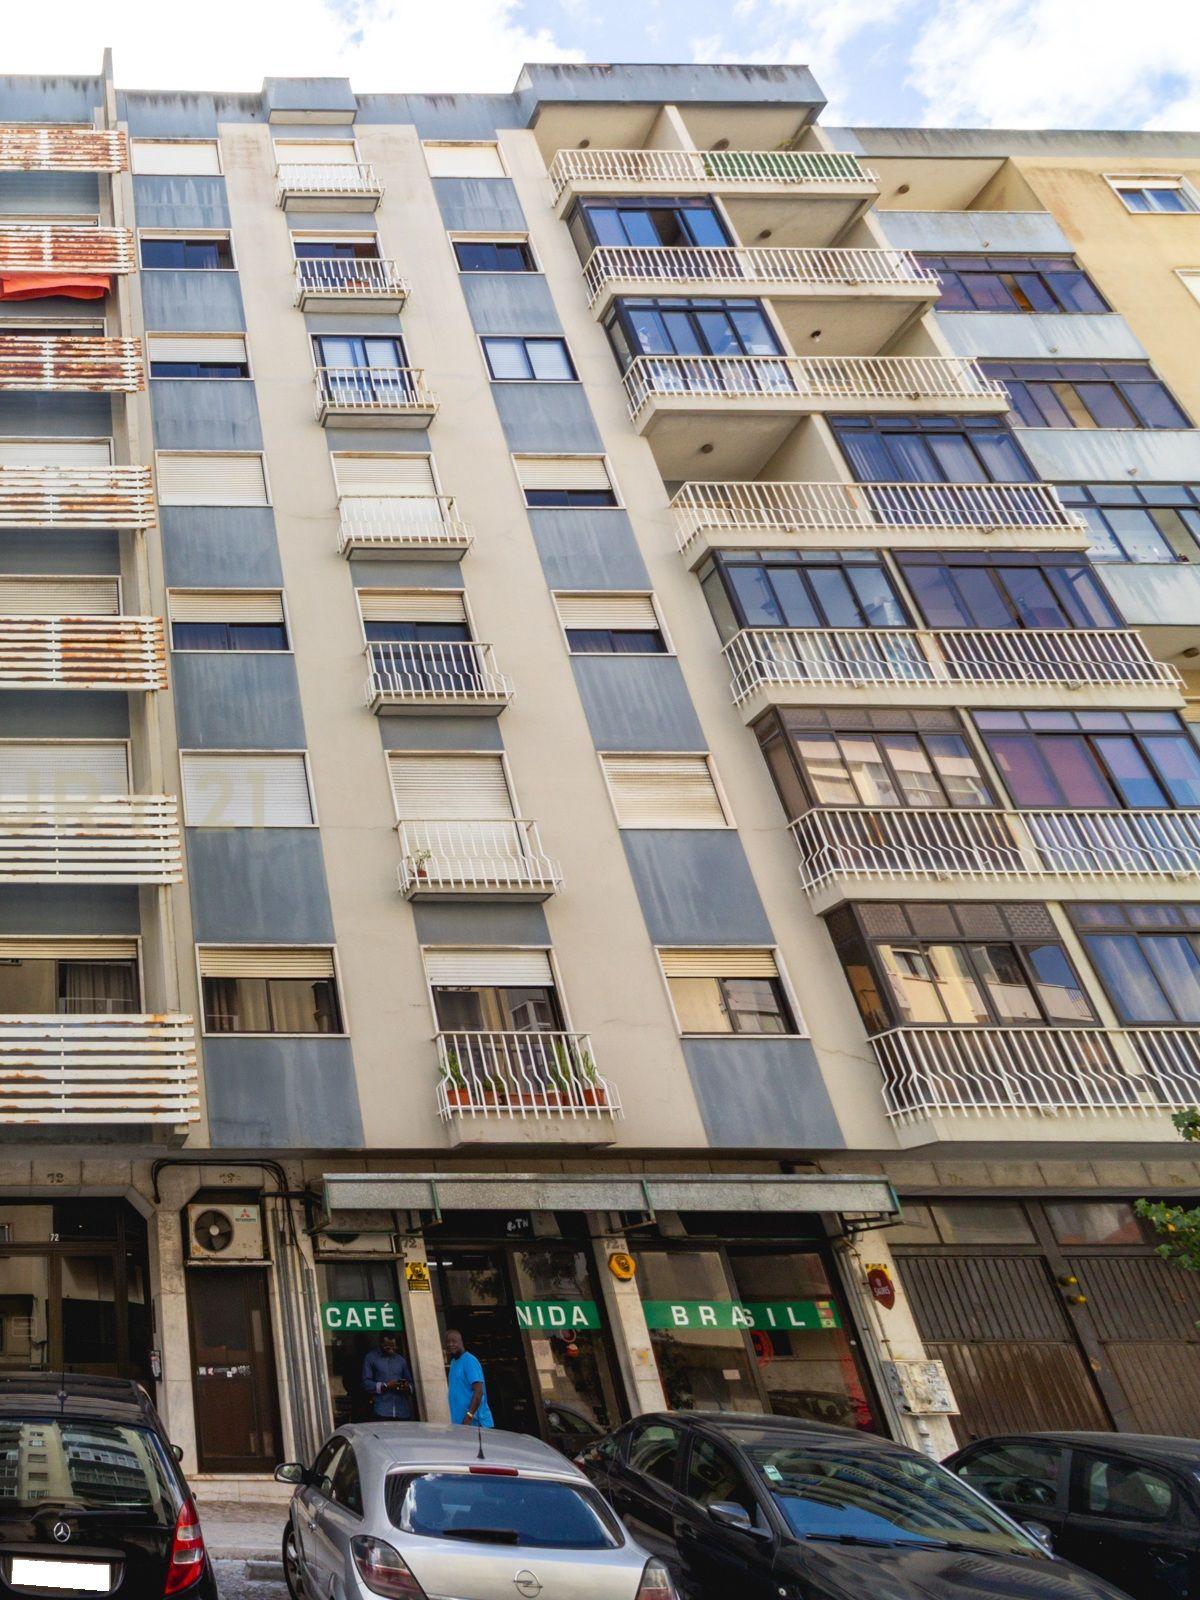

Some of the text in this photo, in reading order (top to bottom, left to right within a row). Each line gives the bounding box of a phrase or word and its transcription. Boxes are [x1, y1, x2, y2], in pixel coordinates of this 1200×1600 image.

[50, 1233, 60, 1241] 72
[325, 1302, 396, 1328] CAFÉ
[670, 1304, 806, 1327] BRASIL
